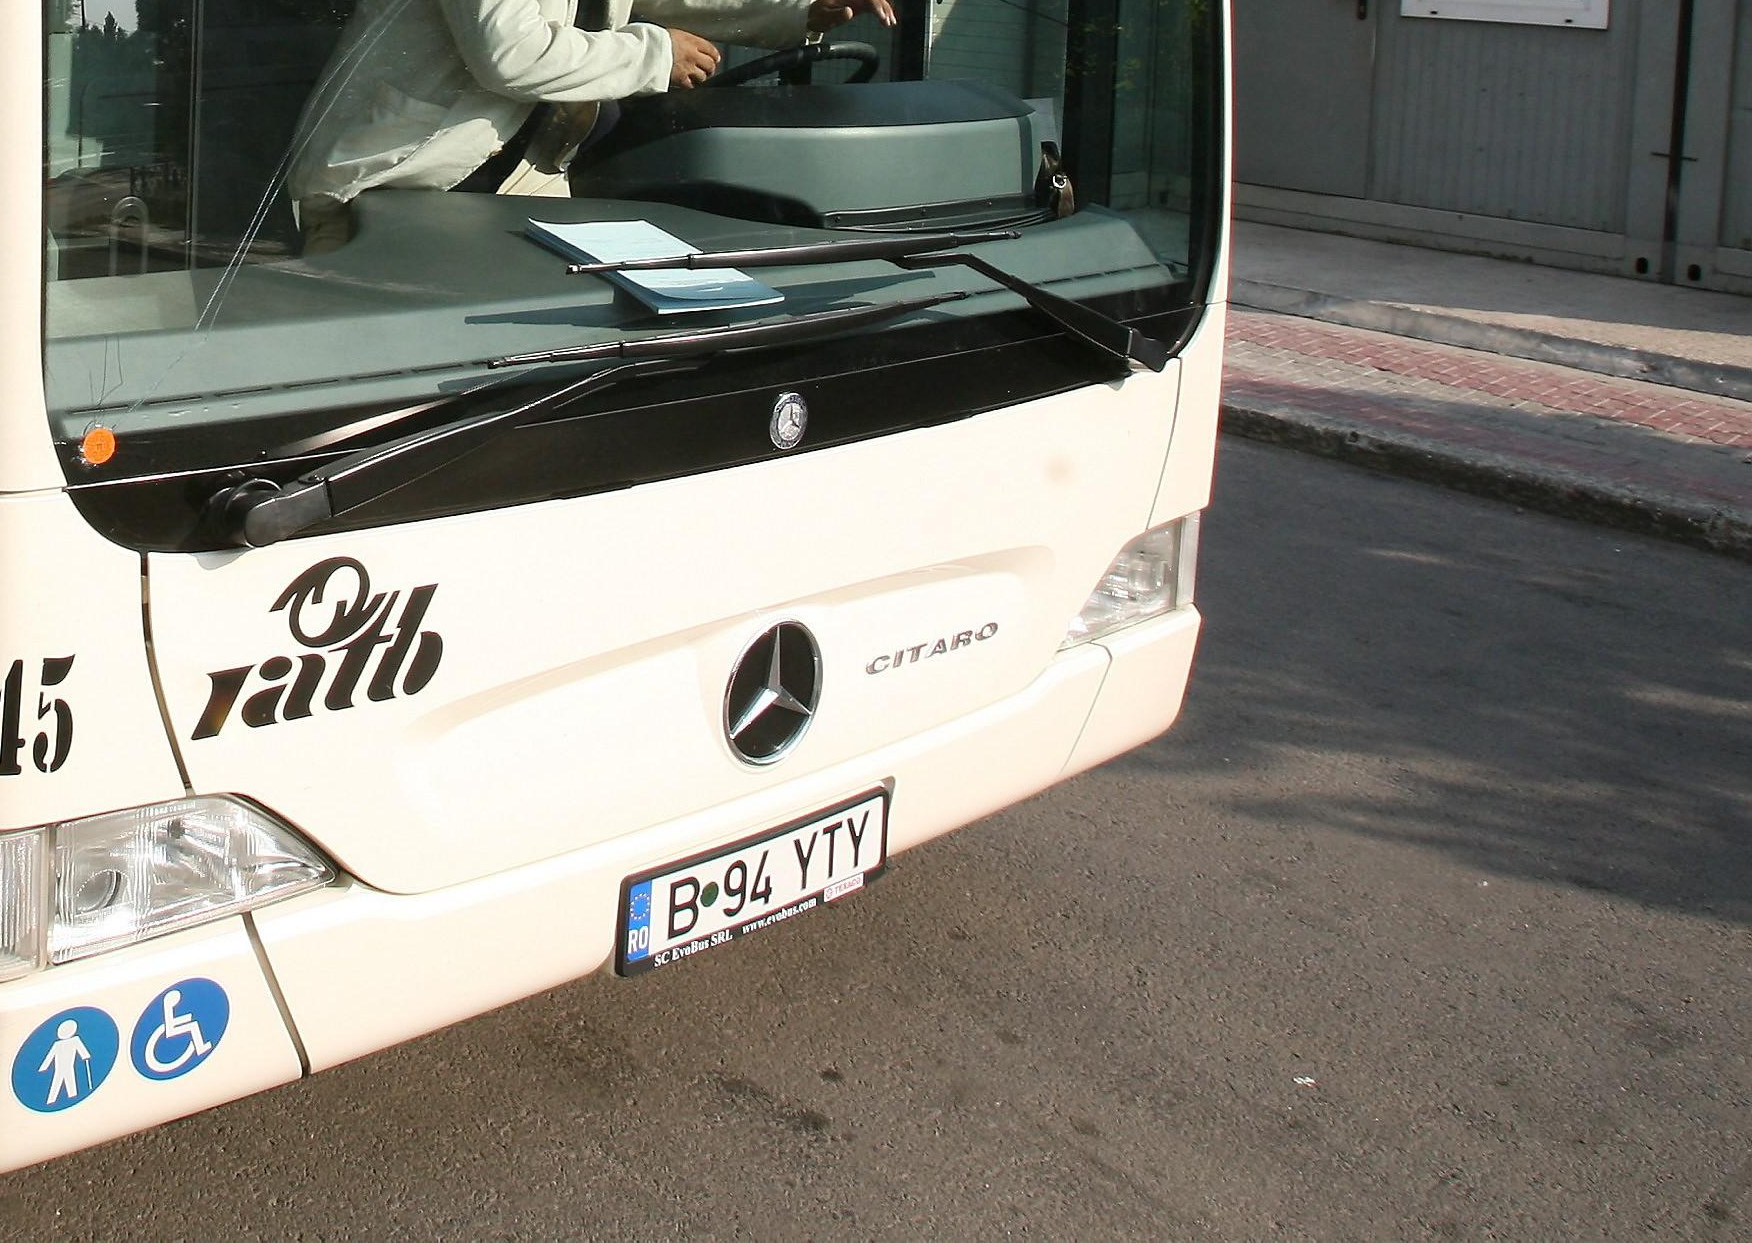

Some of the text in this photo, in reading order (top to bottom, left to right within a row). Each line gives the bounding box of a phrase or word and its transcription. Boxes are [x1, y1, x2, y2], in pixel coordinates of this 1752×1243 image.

[865, 621, 1000, 676] CITARO
[723, 850, 773, 918] 94
[794, 810, 870, 890] YTY
[628, 926, 649, 954] RO
[654, 898, 817, 967] SC EvoBus SRL www.evobus.com
